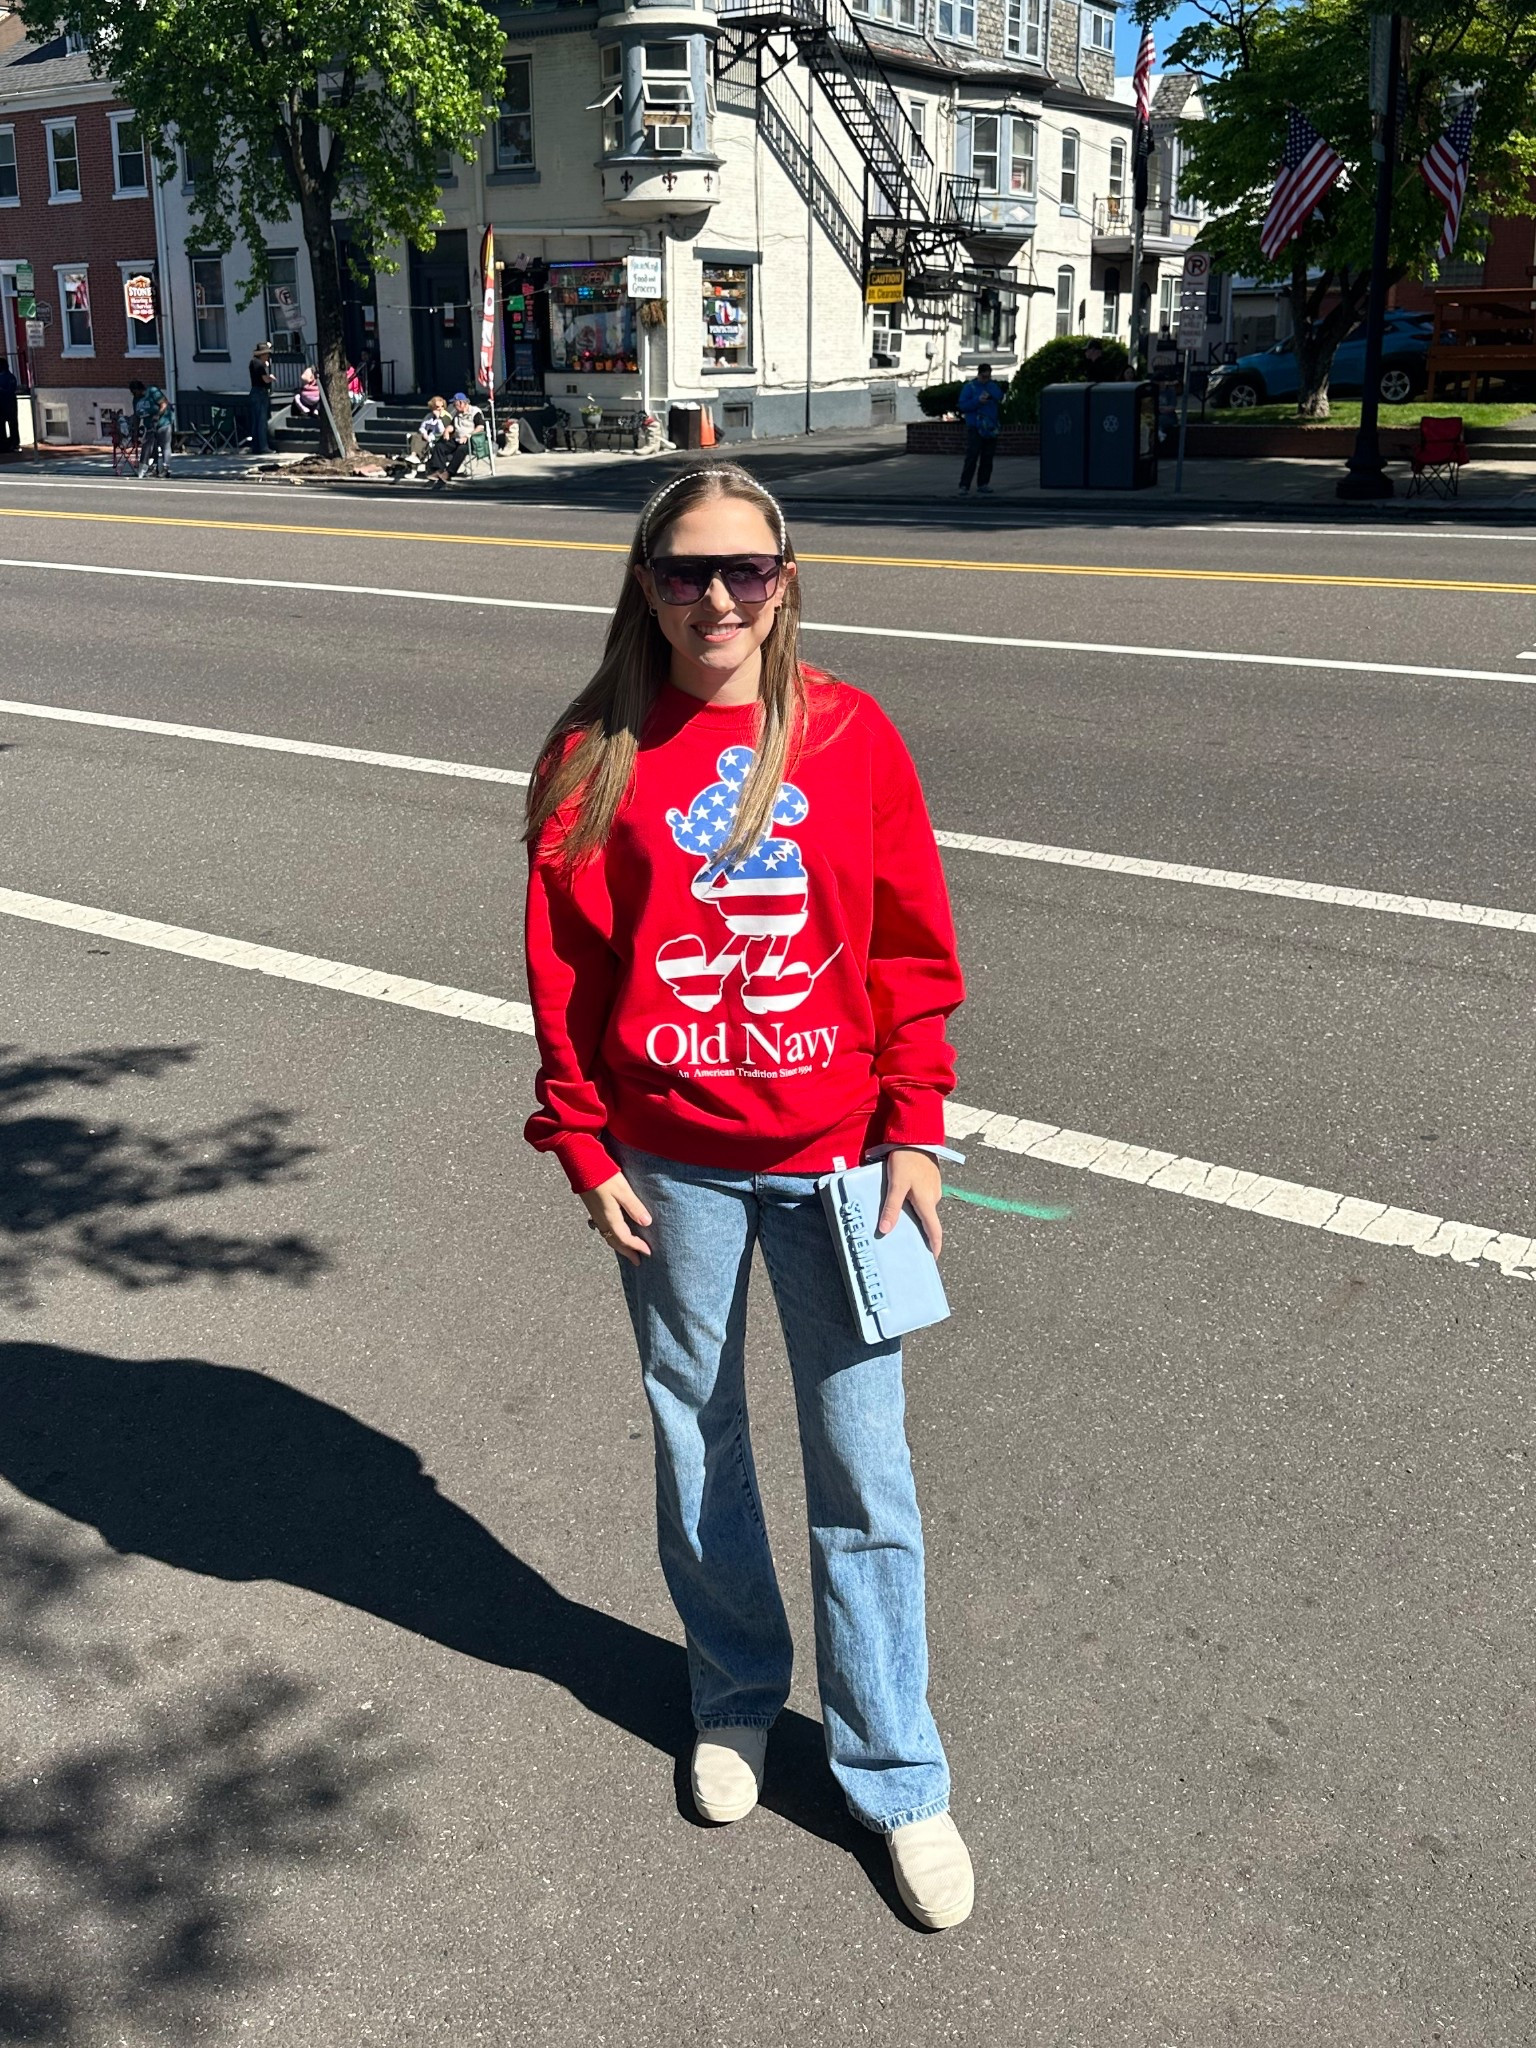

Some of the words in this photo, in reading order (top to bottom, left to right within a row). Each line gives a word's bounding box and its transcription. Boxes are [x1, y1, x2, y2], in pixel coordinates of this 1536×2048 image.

[582, 270, 609, 283] OPEN
[633, 273, 648, 283] Food
[871, 273, 901, 285] CAUTION
[632, 282, 657, 294] Grocery
[646, 1022, 730, 1066] Old
[741, 1022, 839, 1069] Navy
[678, 1070, 690, 1078] An
[694, 1068, 735, 1078] American
[736, 1067, 778, 1079] Tradition
[779, 1068, 798, 1078] Since
[798, 1065, 813, 1075] 1994
